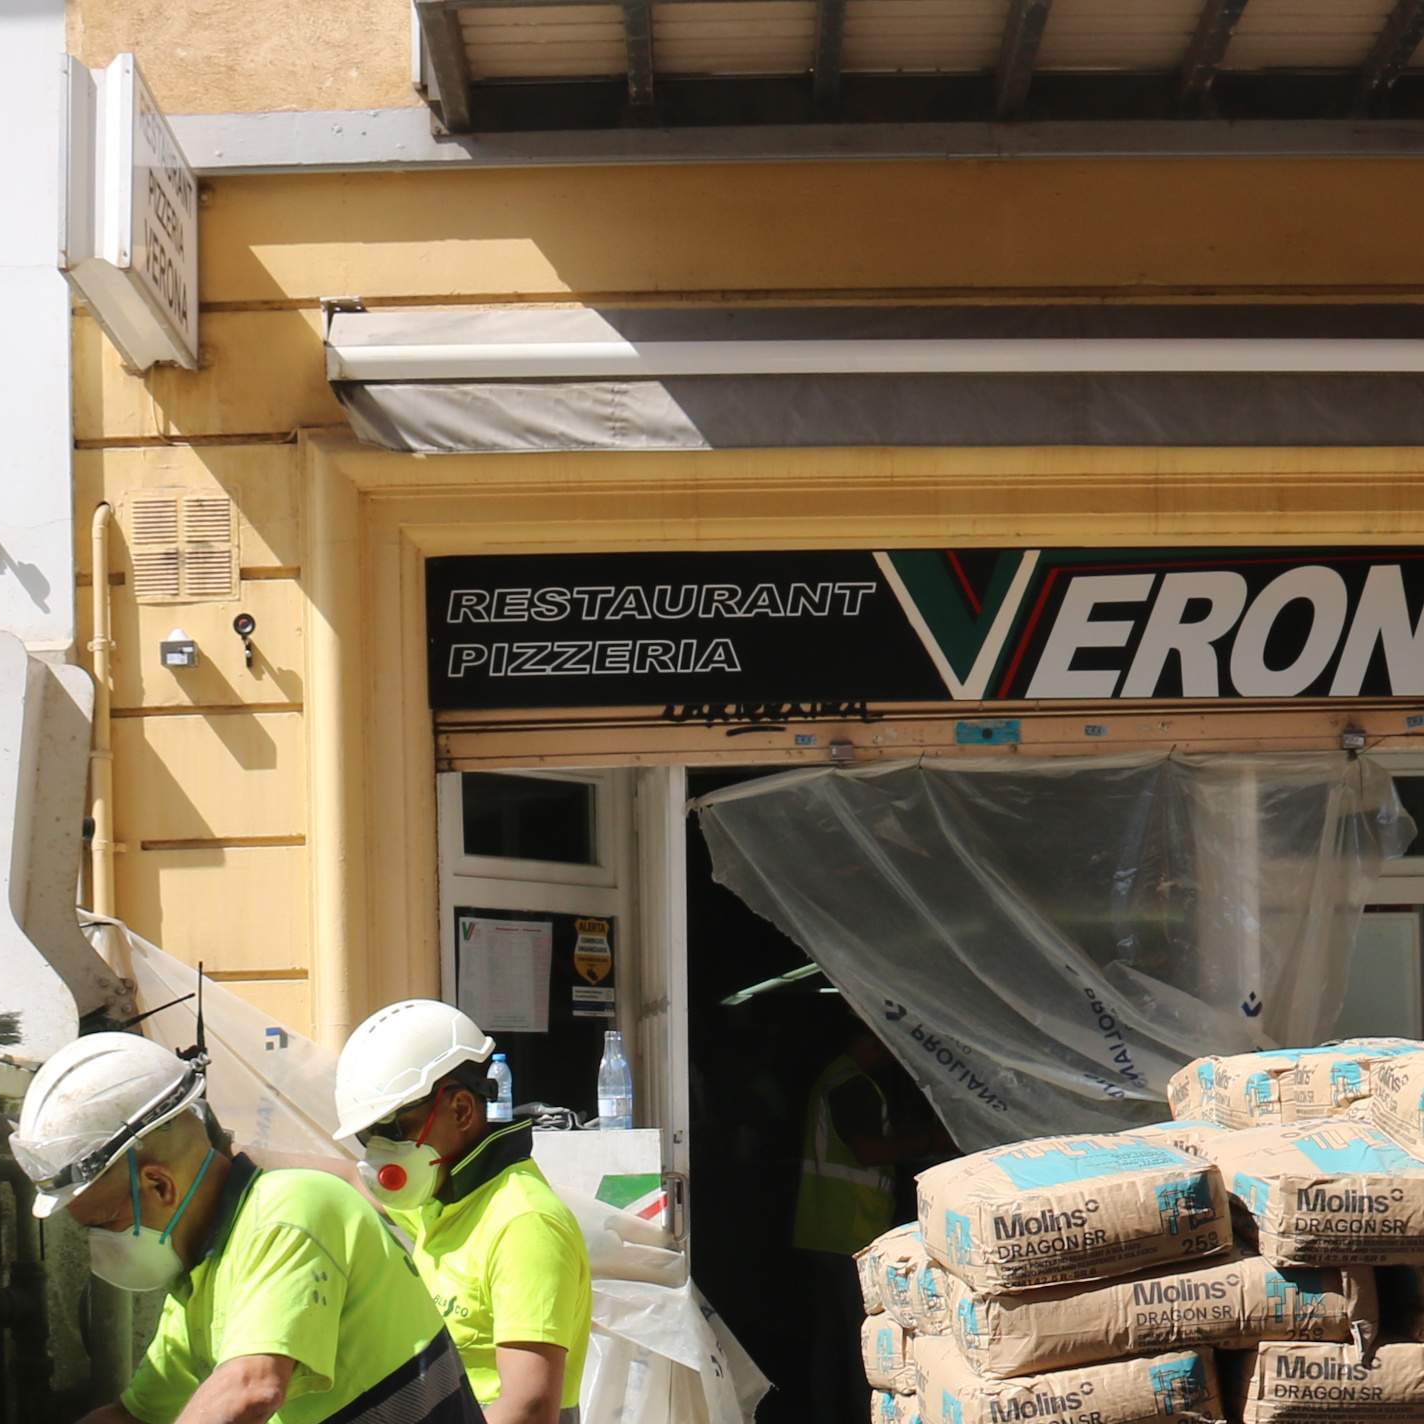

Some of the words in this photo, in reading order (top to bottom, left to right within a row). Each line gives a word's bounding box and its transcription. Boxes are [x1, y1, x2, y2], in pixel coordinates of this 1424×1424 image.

[143, 218, 191, 334] VERONA
[446, 582, 877, 623] RESTAURANT
[447, 638, 742, 677] PIZZERIA
[1295, 1187, 1390, 1214] Molins
[993, 1208, 1088, 1241] Molins
[1295, 1217, 1377, 1234] DRAGON
[1381, 1218, 1407, 1234] SR
[997, 1235, 1079, 1261] DRAGON
[1084, 1229, 1107, 1247] SR
[1132, 1278, 1227, 1306] Molins
[1136, 1307, 1208, 1327] DRAGON
[1212, 1305, 1233, 1320] SR
[1275, 1355, 1368, 1381] Molins
[989, 1390, 1084, 1424] Molins
[1274, 1384, 1356, 1400] DRAGON
[1360, 1386, 1383, 1401] SR
